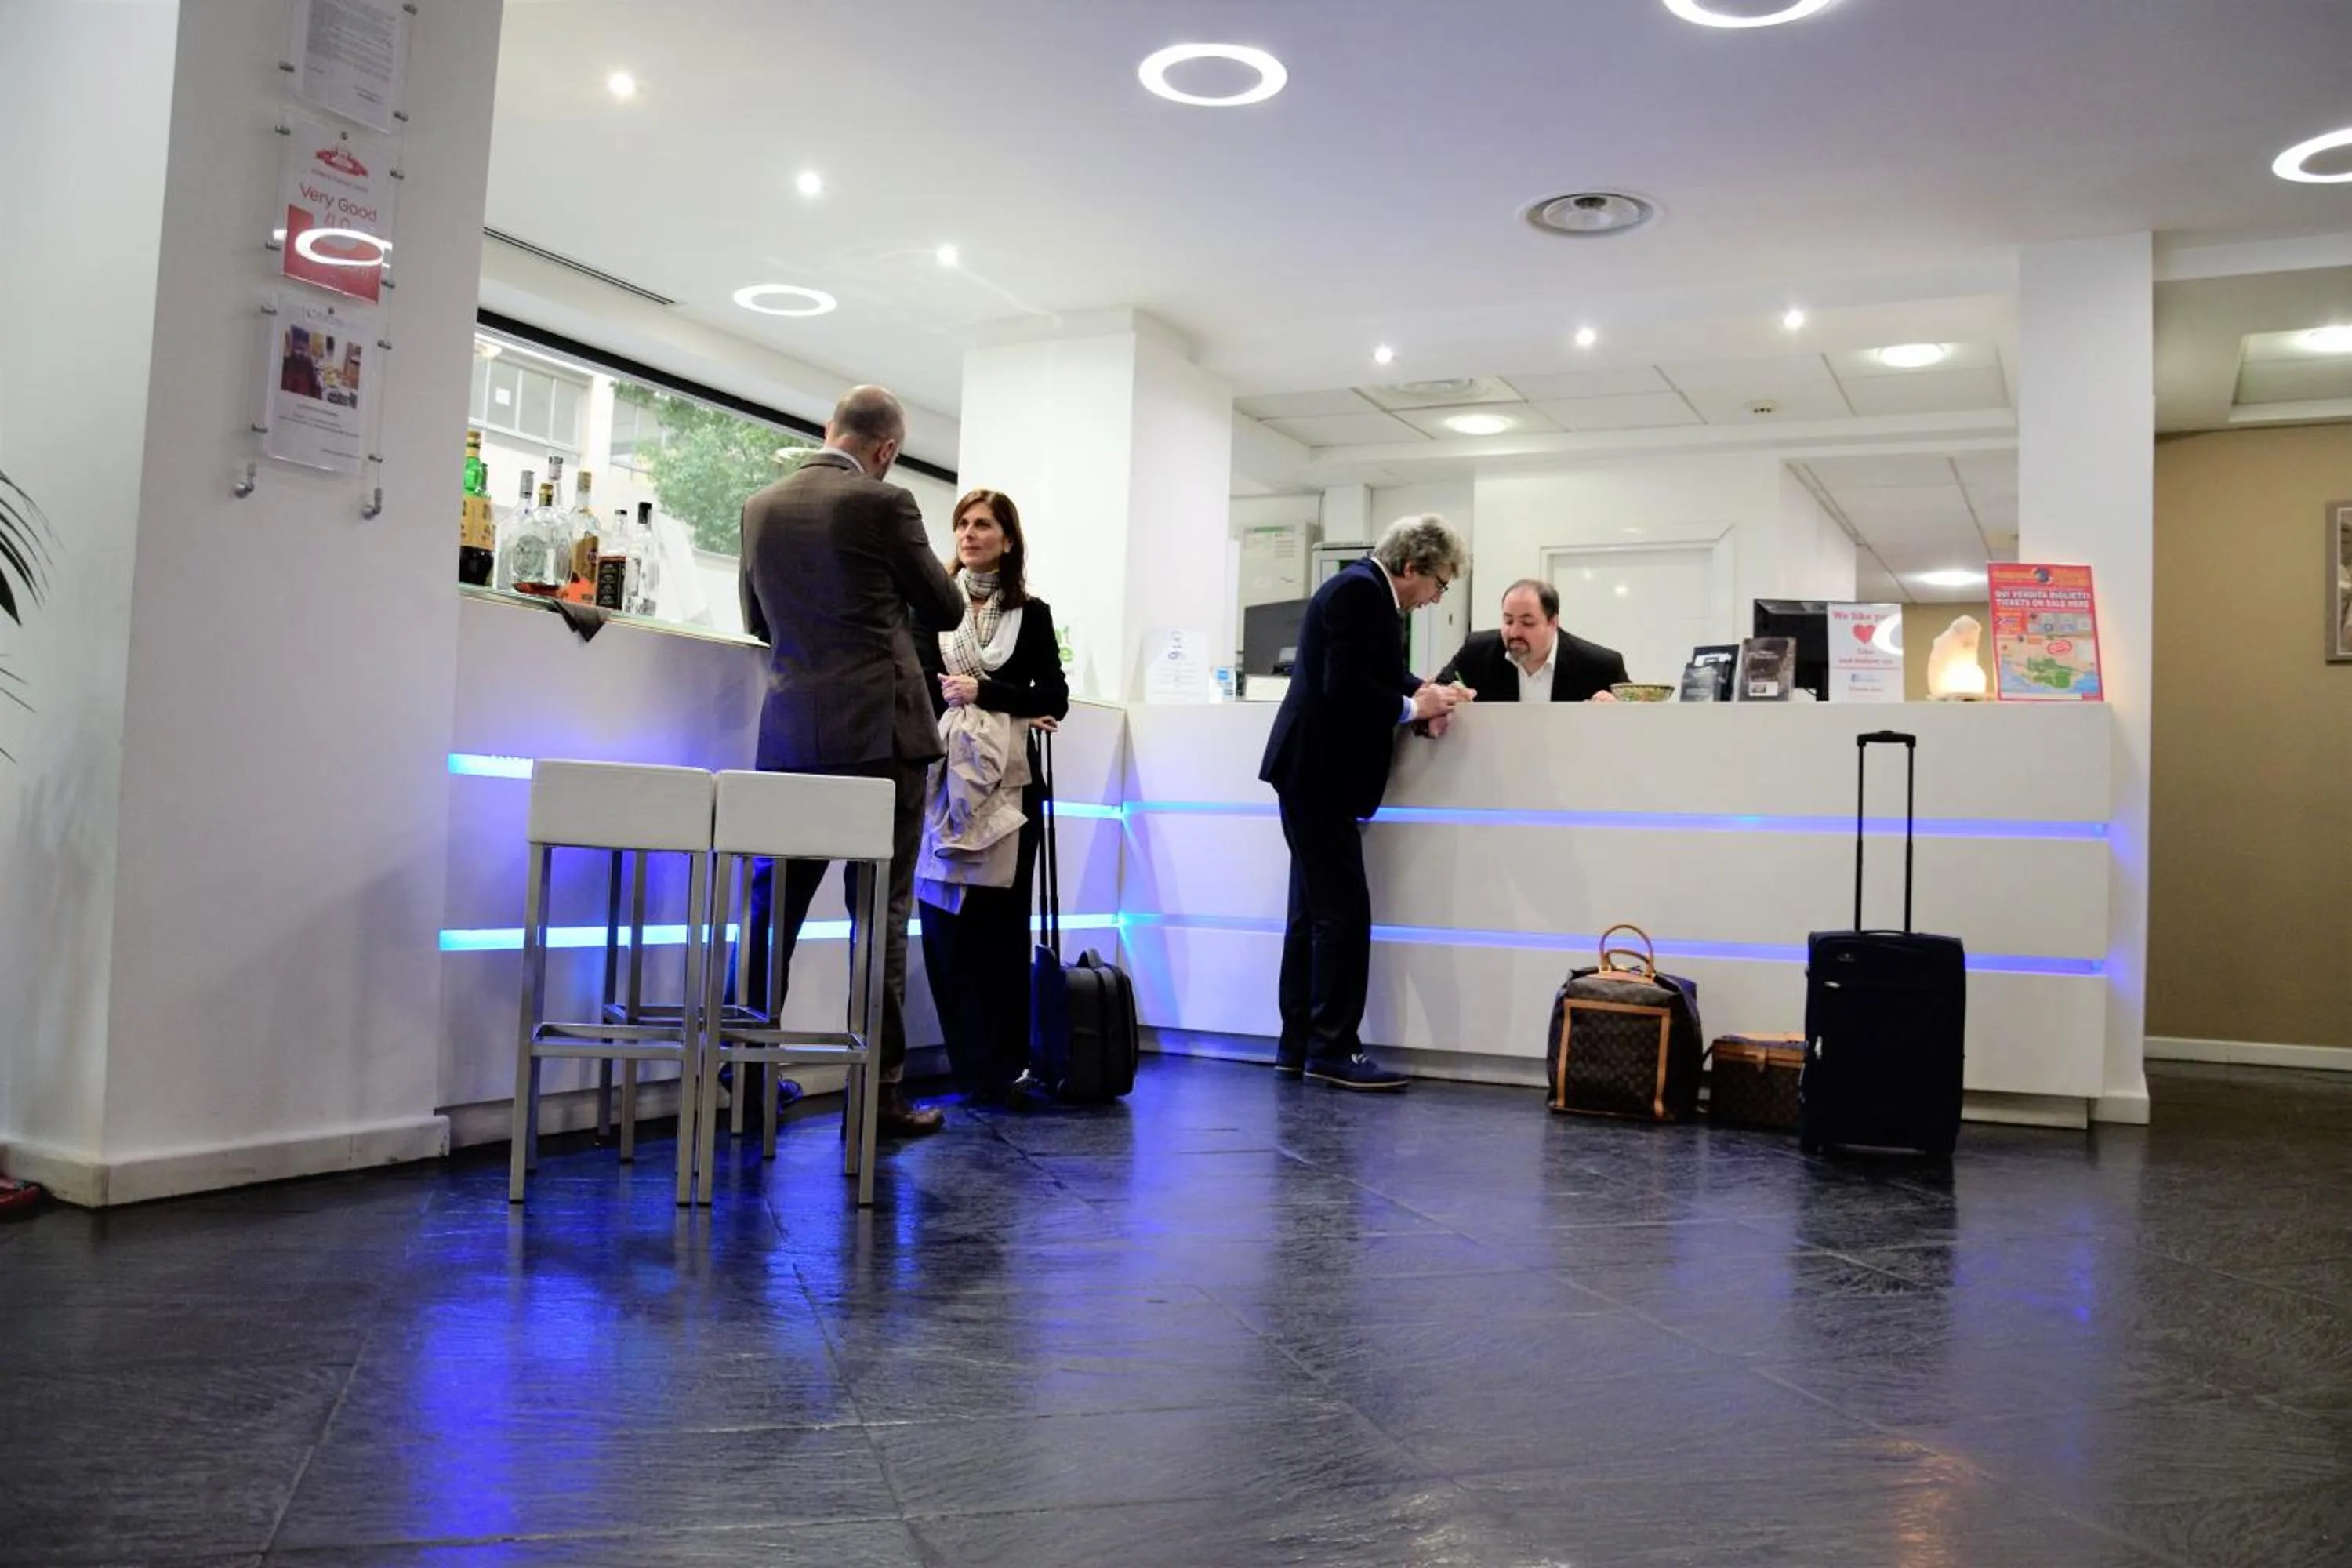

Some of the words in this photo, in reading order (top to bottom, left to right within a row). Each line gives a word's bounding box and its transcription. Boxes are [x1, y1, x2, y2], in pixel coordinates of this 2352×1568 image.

[299, 182, 335, 209] Very
[338, 198, 378, 223] Good
[1995, 598, 2031, 608] TICKETS
[2031, 599, 2045, 608] ON
[2045, 599, 2067, 608] SALE
[2067, 600, 2090, 608] HERE
[1832, 612, 1849, 620] We
[1851, 612, 1871, 620] like
